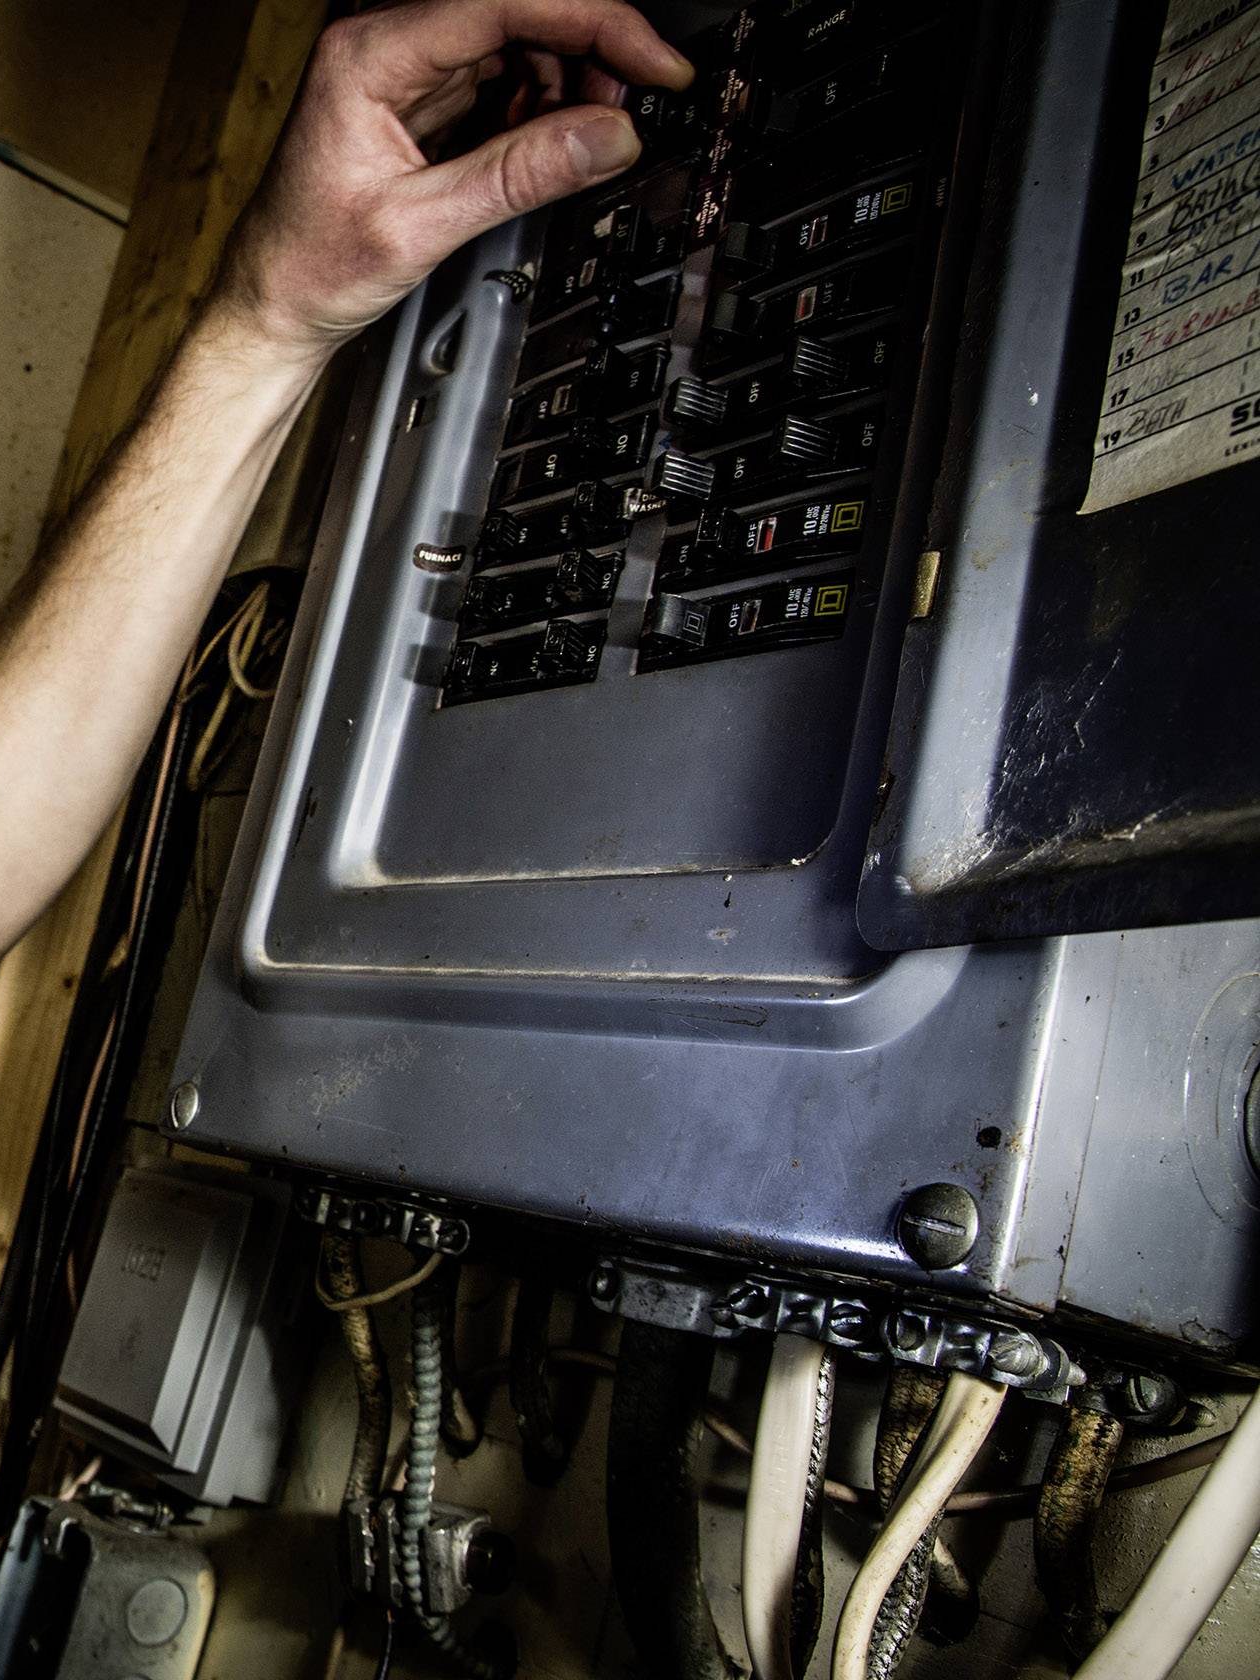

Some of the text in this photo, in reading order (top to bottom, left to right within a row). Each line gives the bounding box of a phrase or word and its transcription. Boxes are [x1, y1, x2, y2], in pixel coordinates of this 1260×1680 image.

[808, 9, 847, 39] RANGE
[825, 80, 838, 105] OFF
[1159, 78, 1167, 93] 1
[1154, 115, 1166, 132] 3
[1148, 154, 1160, 172] 5
[1142, 191, 1155, 209] 7
[799, 223, 810, 246] OFF
[1136, 231, 1148, 248] 9
[1130, 268, 1145, 287] 11
[1162, 253, 1234, 305] BAR
[822, 280, 835, 304] OFF
[1123, 307, 1141, 327] 13
[873, 340, 886, 364] OFF
[1117, 347, 1135, 368] 15
[748, 380, 761, 403] OFF
[1110, 387, 1130, 409] 17
[1123, 397, 1189, 438] BATH
[615, 433, 629, 456] ON
[860, 422, 875, 447] OFF
[1102, 429, 1122, 449] 19
[544, 453, 559, 478] OFF
[733, 456, 747, 480] OFF
[746, 522, 758, 548] OFF
[419, 550, 462, 562] FURNAC
[678, 544, 690, 563] ON
[601, 572, 612, 590] ON
[728, 603, 740, 628] OFF
[586, 645, 597, 663] ON
